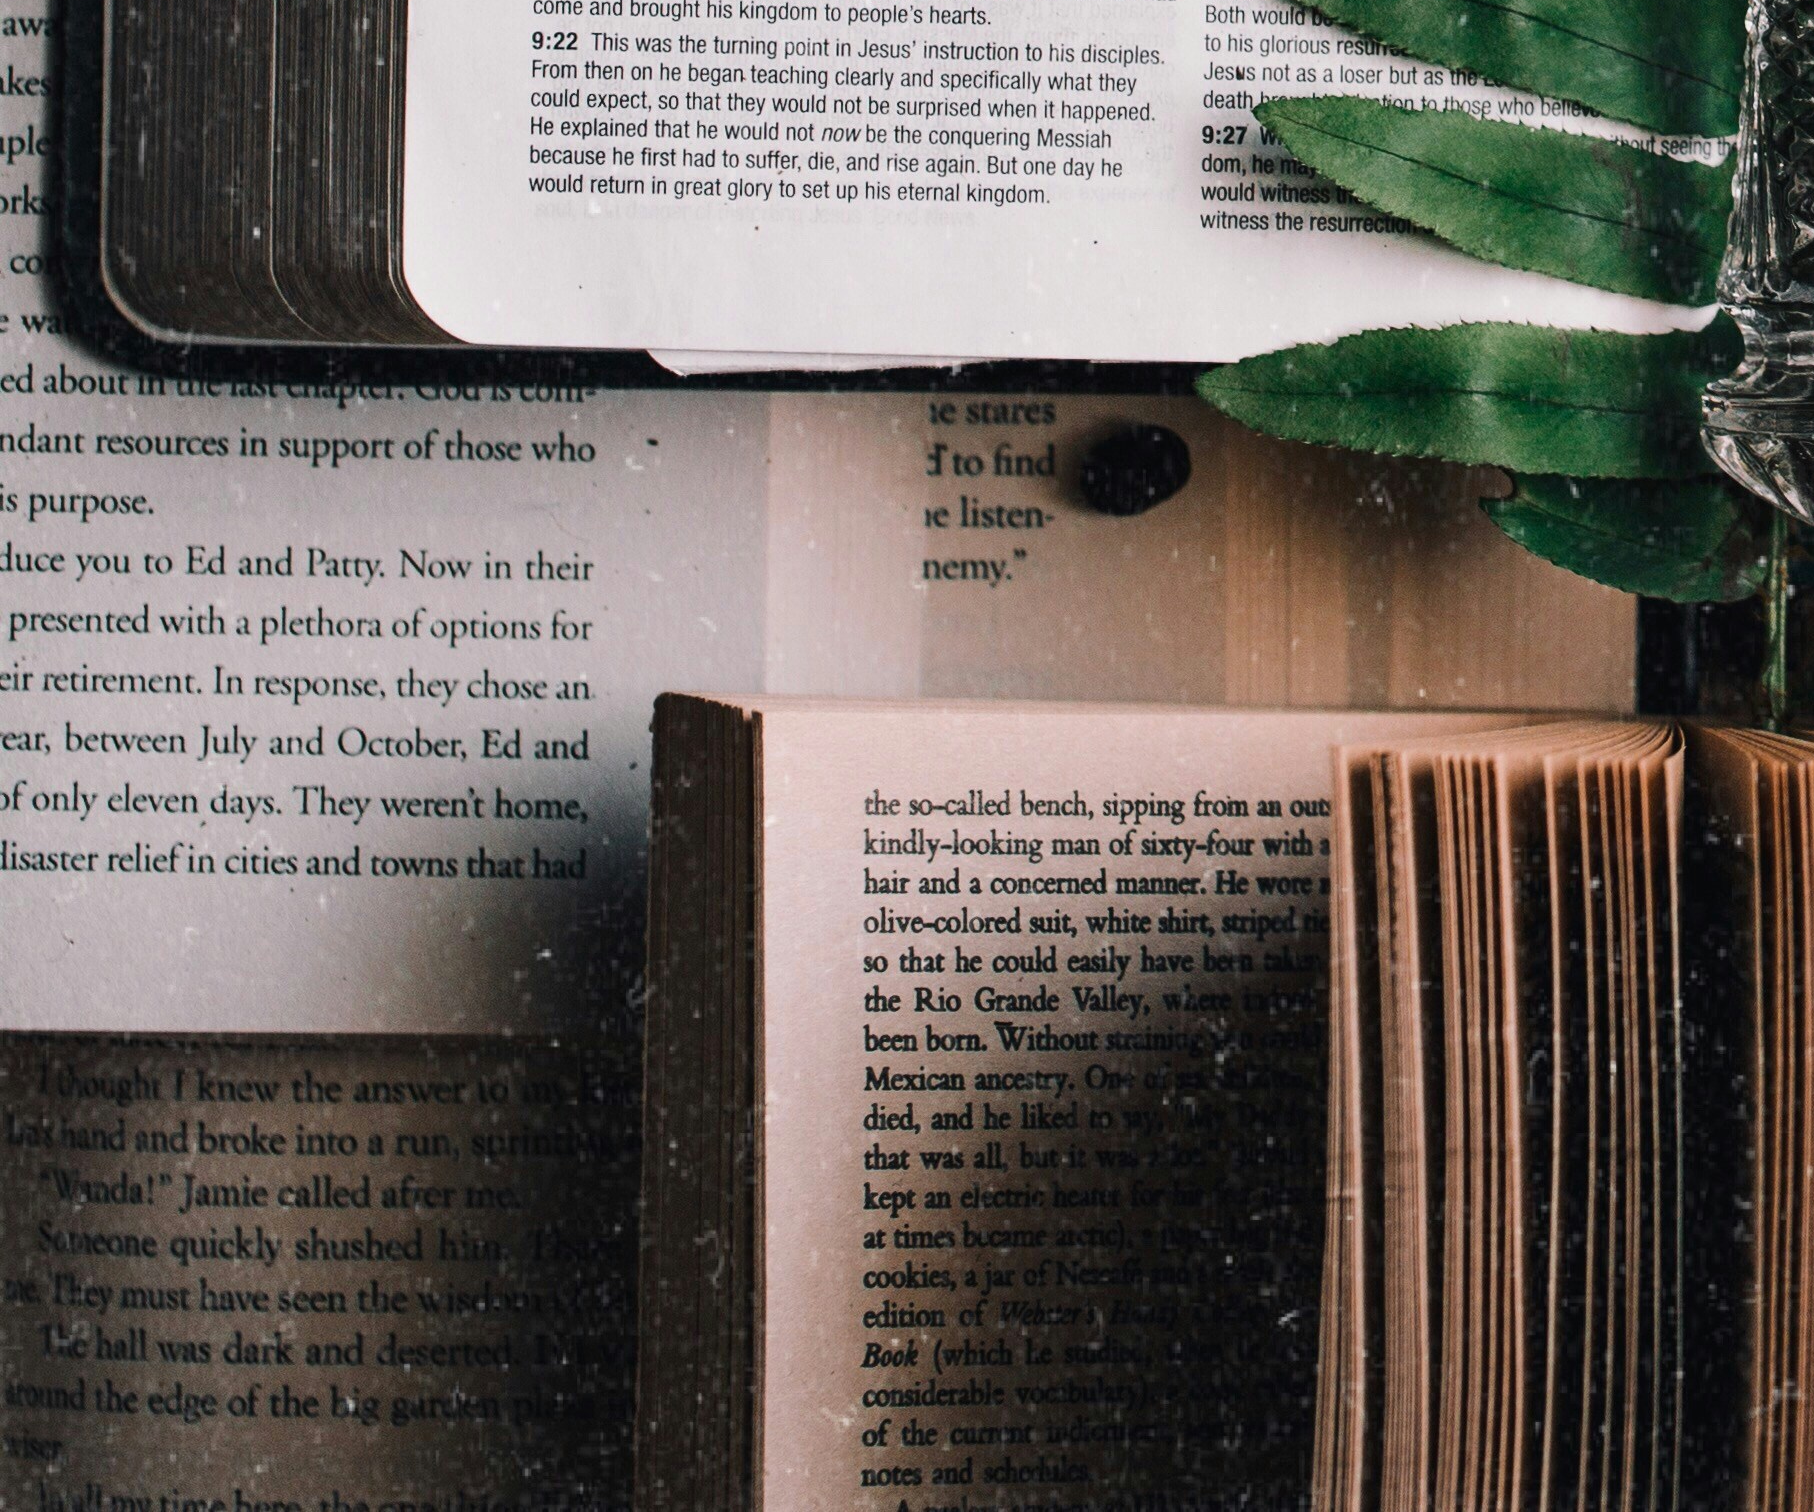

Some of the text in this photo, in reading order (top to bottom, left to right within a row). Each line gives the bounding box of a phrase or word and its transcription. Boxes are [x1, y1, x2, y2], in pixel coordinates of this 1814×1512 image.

[29, 494, 153, 522] purpose.
[76, 545, 593, 586] you to Ed and Patty. Now in their
[865, 789, 1282, 825] the so-called bench, sipping from an
[864, 867, 1206, 894] hair and a concerned manner.
